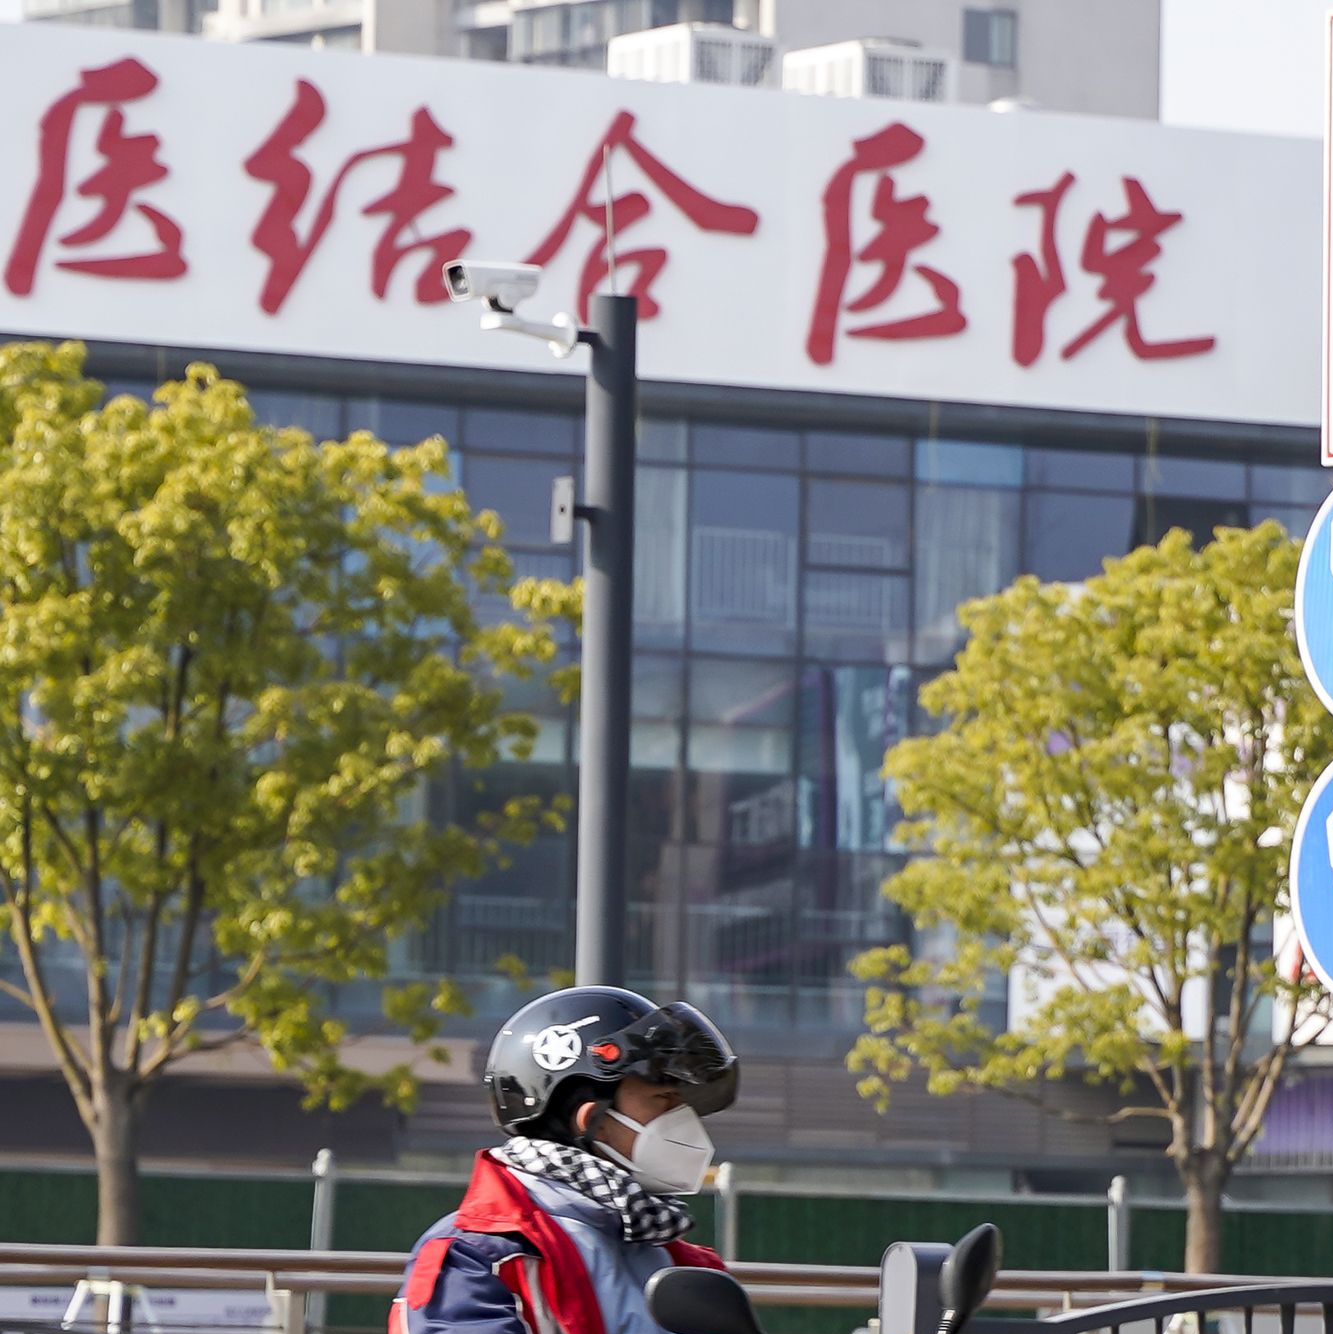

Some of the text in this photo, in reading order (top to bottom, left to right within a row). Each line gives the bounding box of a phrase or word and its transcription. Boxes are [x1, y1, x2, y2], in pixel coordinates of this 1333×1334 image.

[4, 55, 1216, 368] 医结合医院
